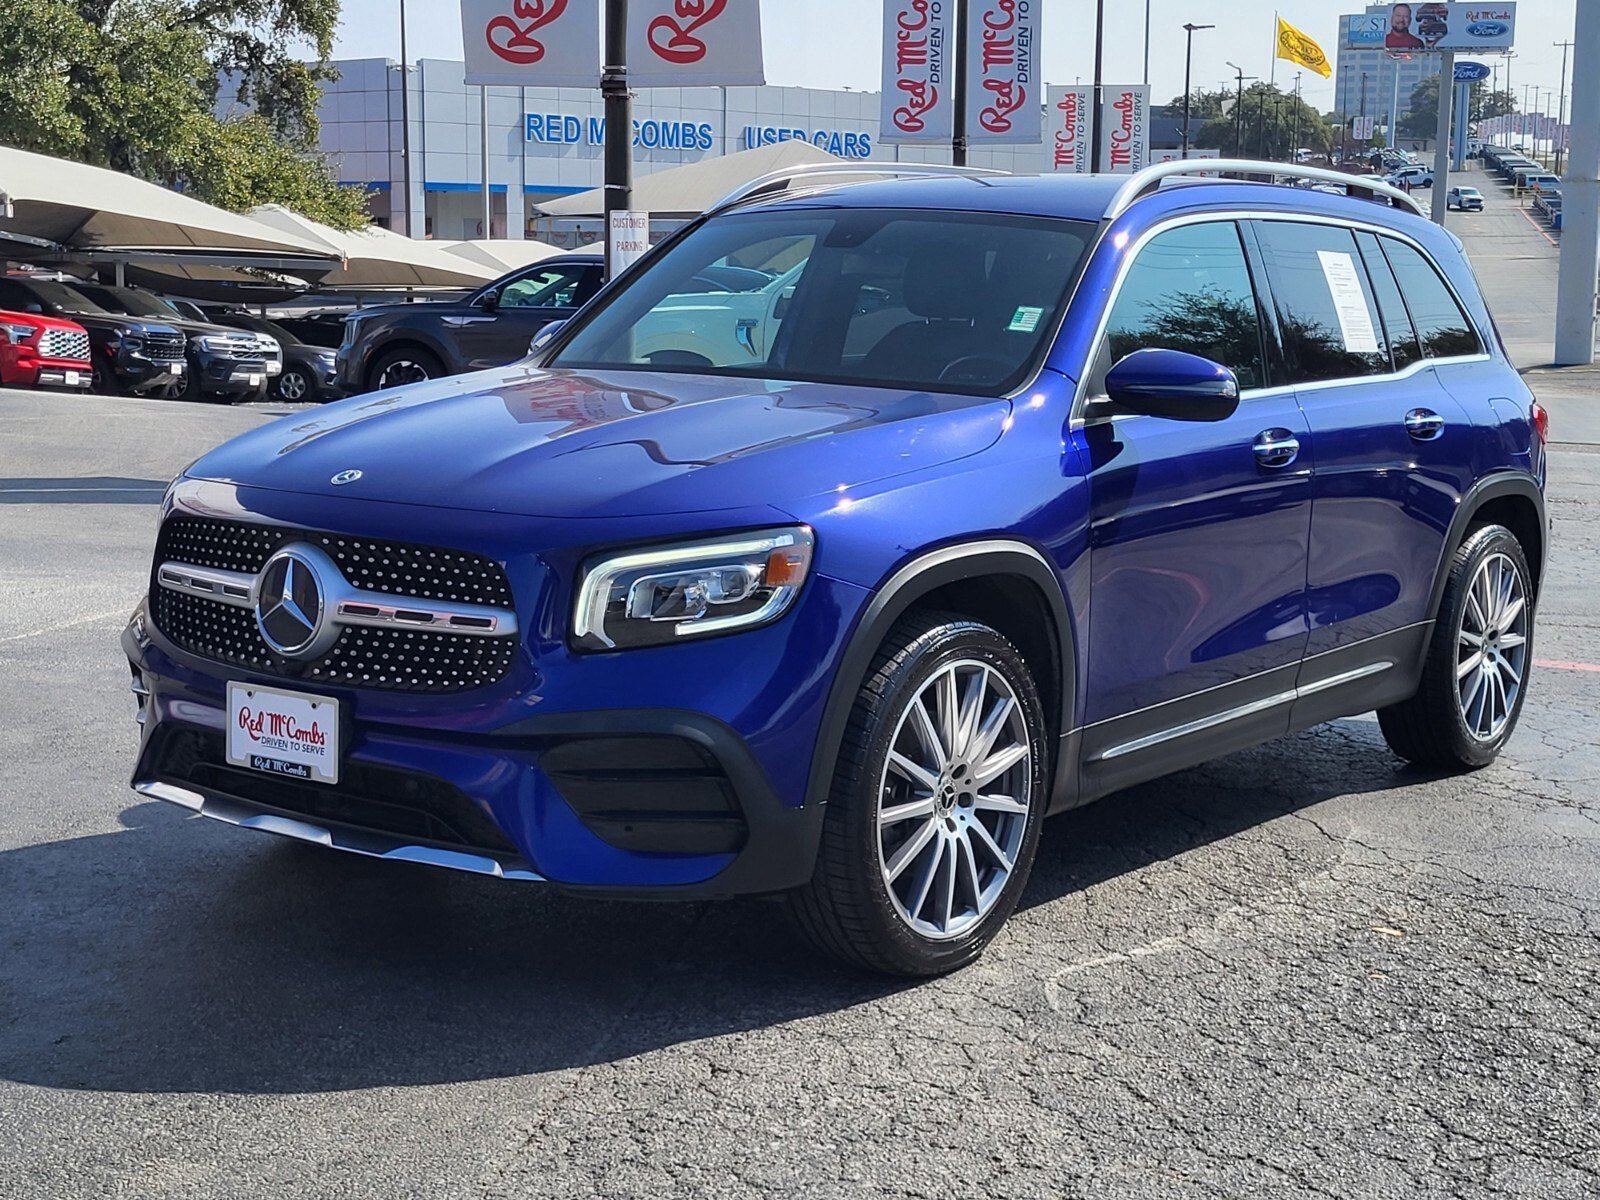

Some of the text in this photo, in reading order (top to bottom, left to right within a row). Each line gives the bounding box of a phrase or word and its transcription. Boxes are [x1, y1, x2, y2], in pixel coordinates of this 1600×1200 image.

[485, 0, 568, 65] Re
[647, 0, 728, 64] Re
[1370, 17, 1387, 31] ST
[1474, 25, 1500, 35] Ford
[930, 1, 942, 84] DRIVEN TO
[1017, 0, 1030, 84] DRIVEN TO
[893, 0, 938, 133] Red McCo
[979, 0, 1026, 133] Red McCo
[1076, 93, 1086, 122] SERVE
[1133, 92, 1142, 122] SERVE
[525, 113, 713, 150] RED MOMBS
[813, 130, 871, 157] CARS
[1054, 92, 1077, 171] McCombs
[1077, 125, 1085, 138] TO
[1110, 92, 1133, 171] McCombs
[1133, 124, 1142, 138] TO
[612, 217, 646, 228] CUSTOMER
[616, 241, 643, 251] PARKING
[239, 706, 325, 746] Red McCombs
[261, 736, 325, 756] DRIVEN TO SERVE
[254, 757, 307, 777] Red McCombs
